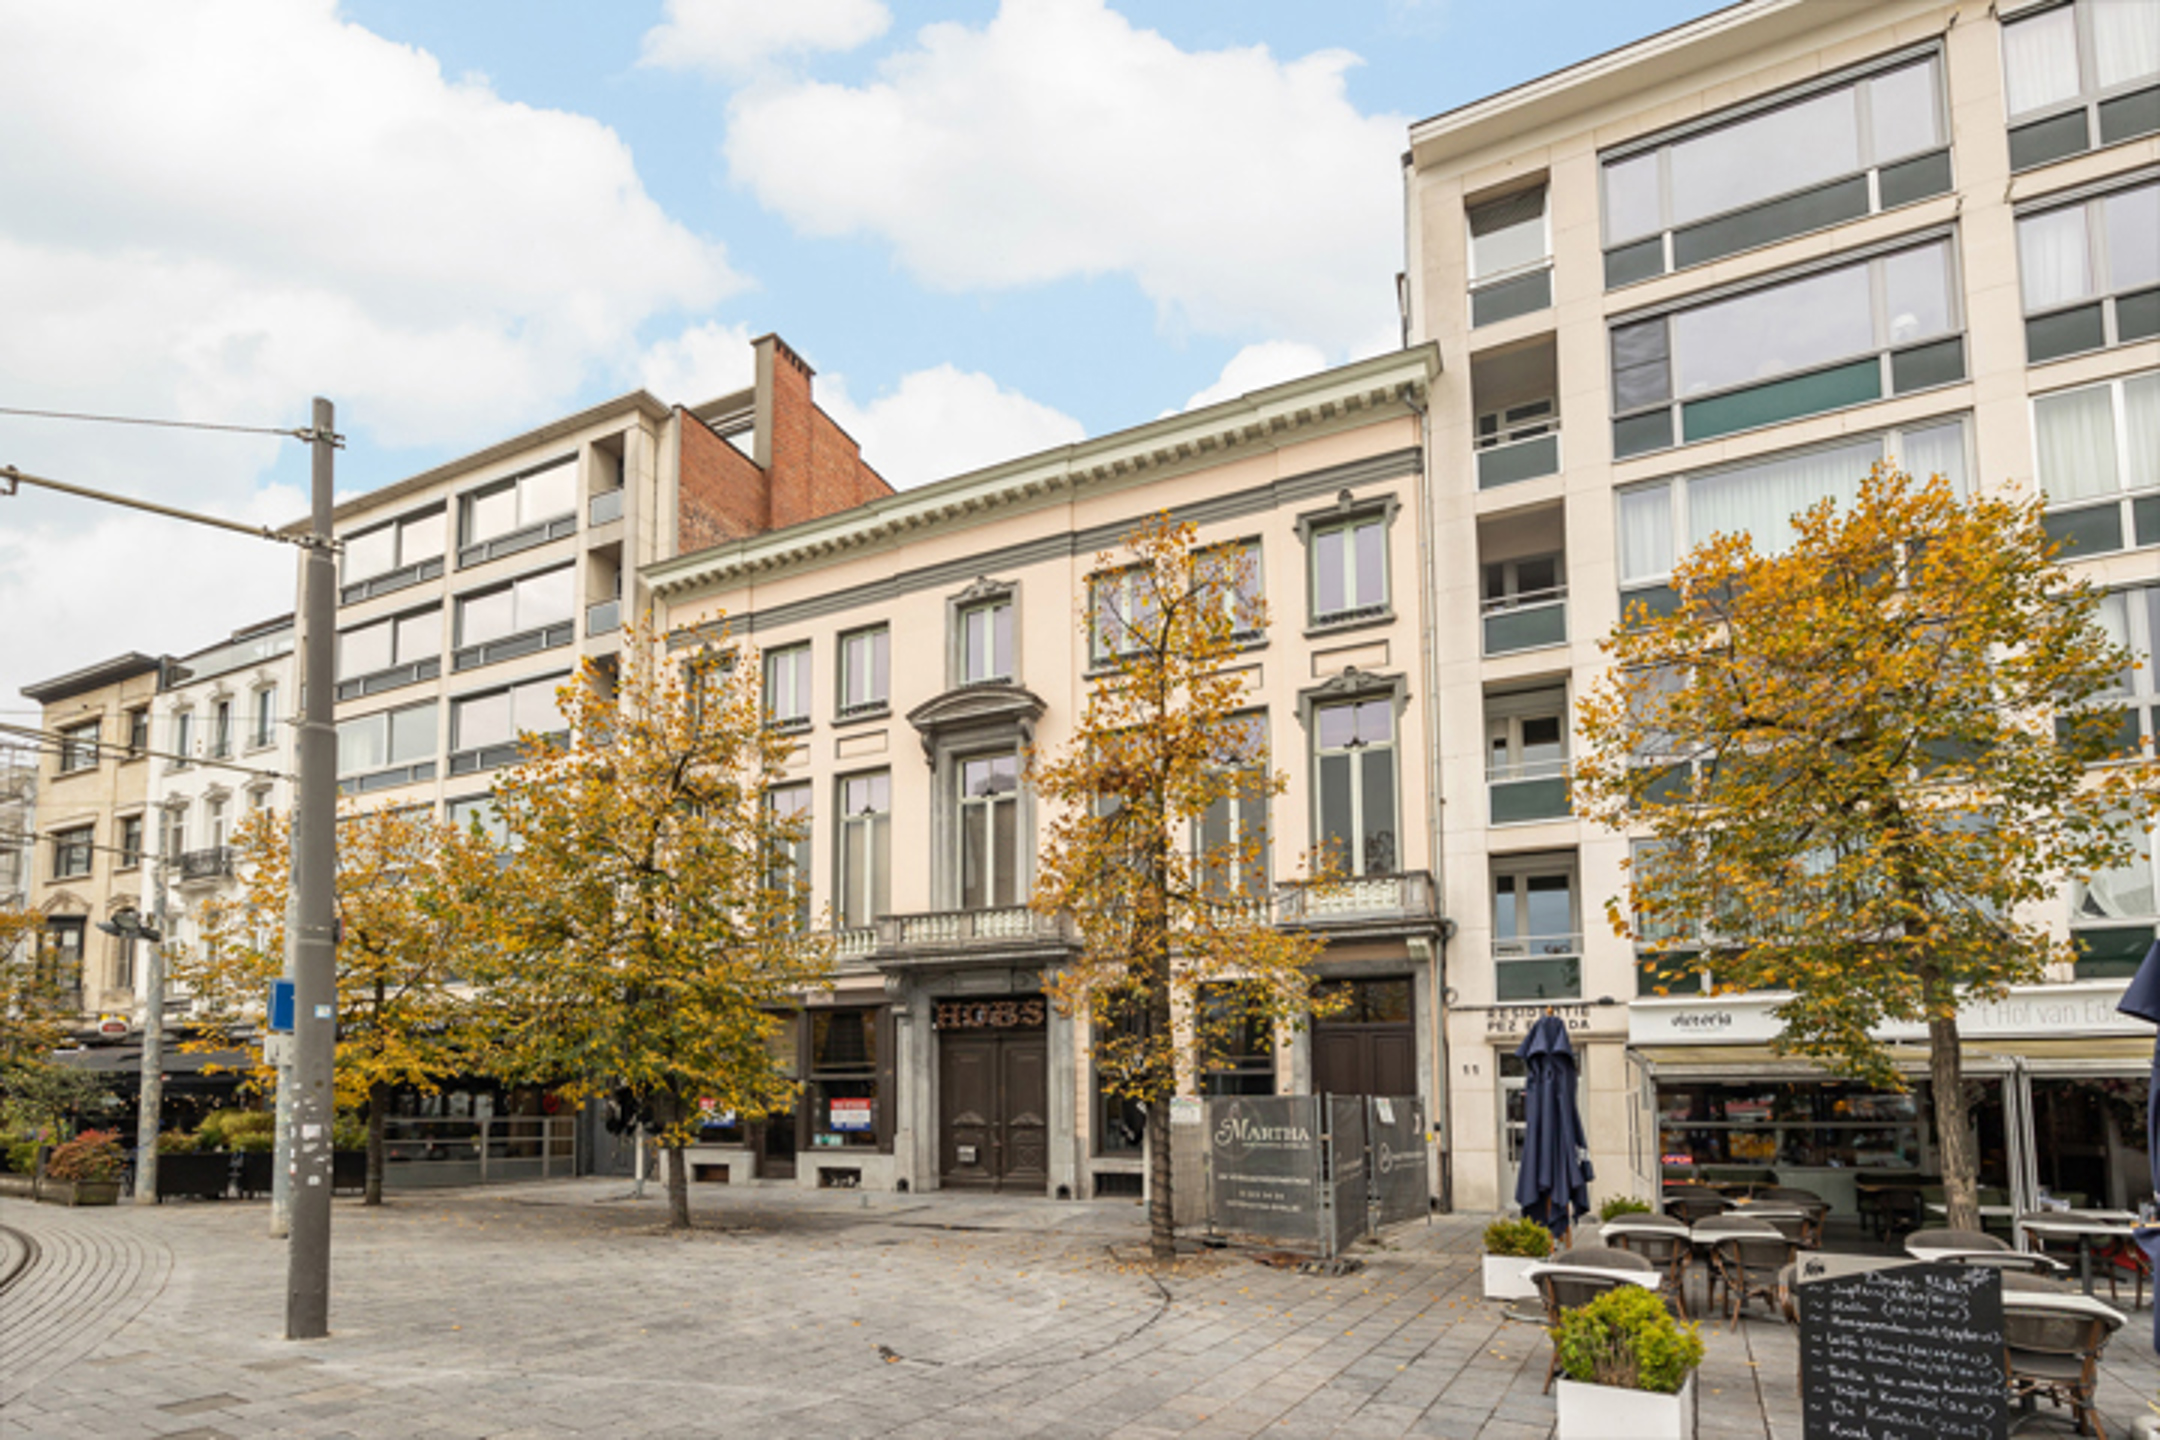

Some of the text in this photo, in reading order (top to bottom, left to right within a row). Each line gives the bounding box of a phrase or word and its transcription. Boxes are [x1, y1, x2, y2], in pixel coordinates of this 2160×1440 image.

[1997, 1000, 2031, 1026] Hof
[2036, 1004, 2077, 1024] van
[2084, 999, 2126, 1023] Ede
